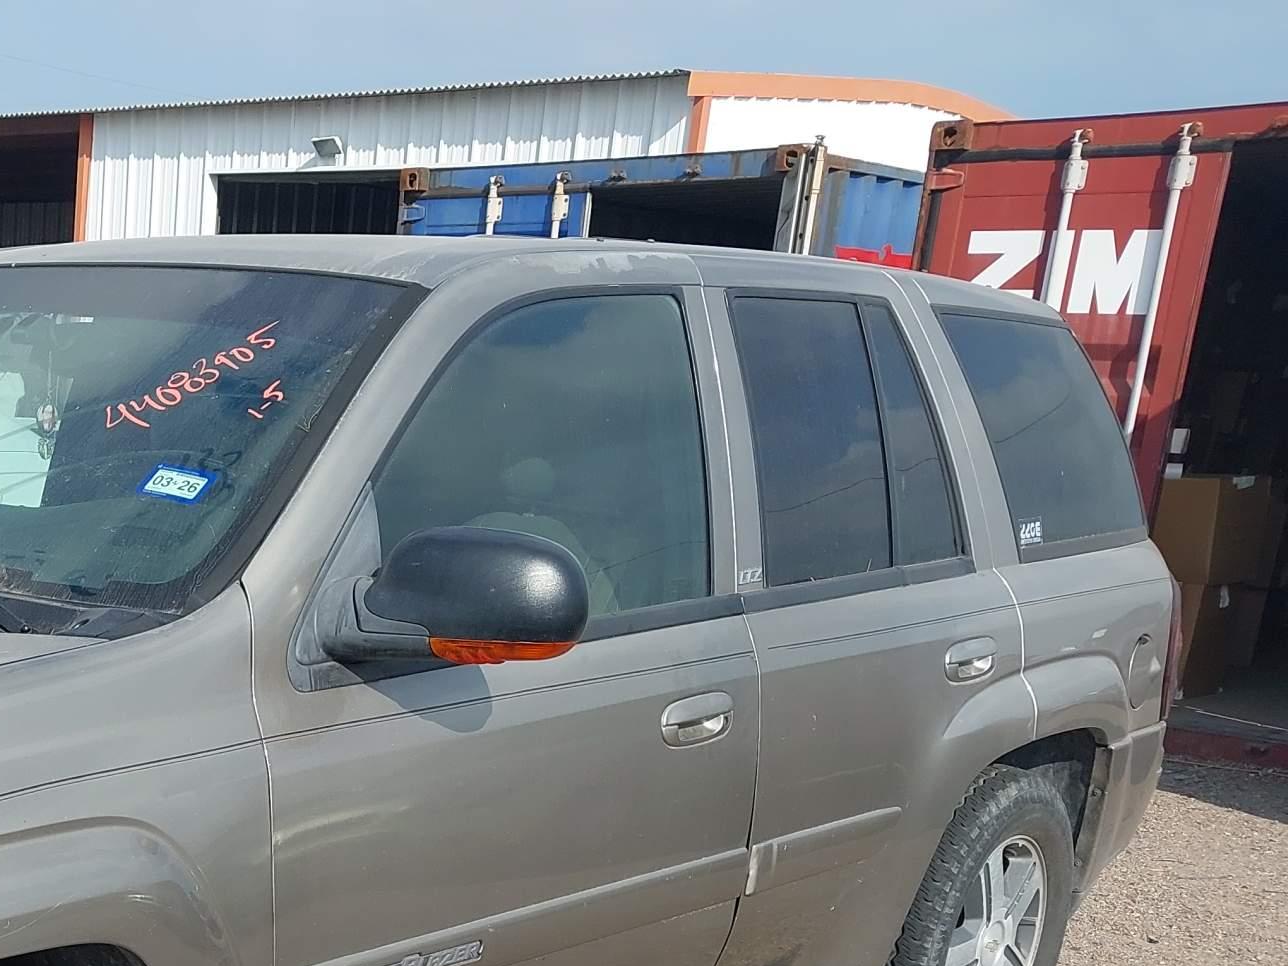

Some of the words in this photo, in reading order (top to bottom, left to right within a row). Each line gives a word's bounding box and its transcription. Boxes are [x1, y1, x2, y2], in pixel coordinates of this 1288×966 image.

[967, 230, 1163, 315] ZIM
[105, 319, 280, 429] 44083905
[247, 379, 284, 419] 1-5
